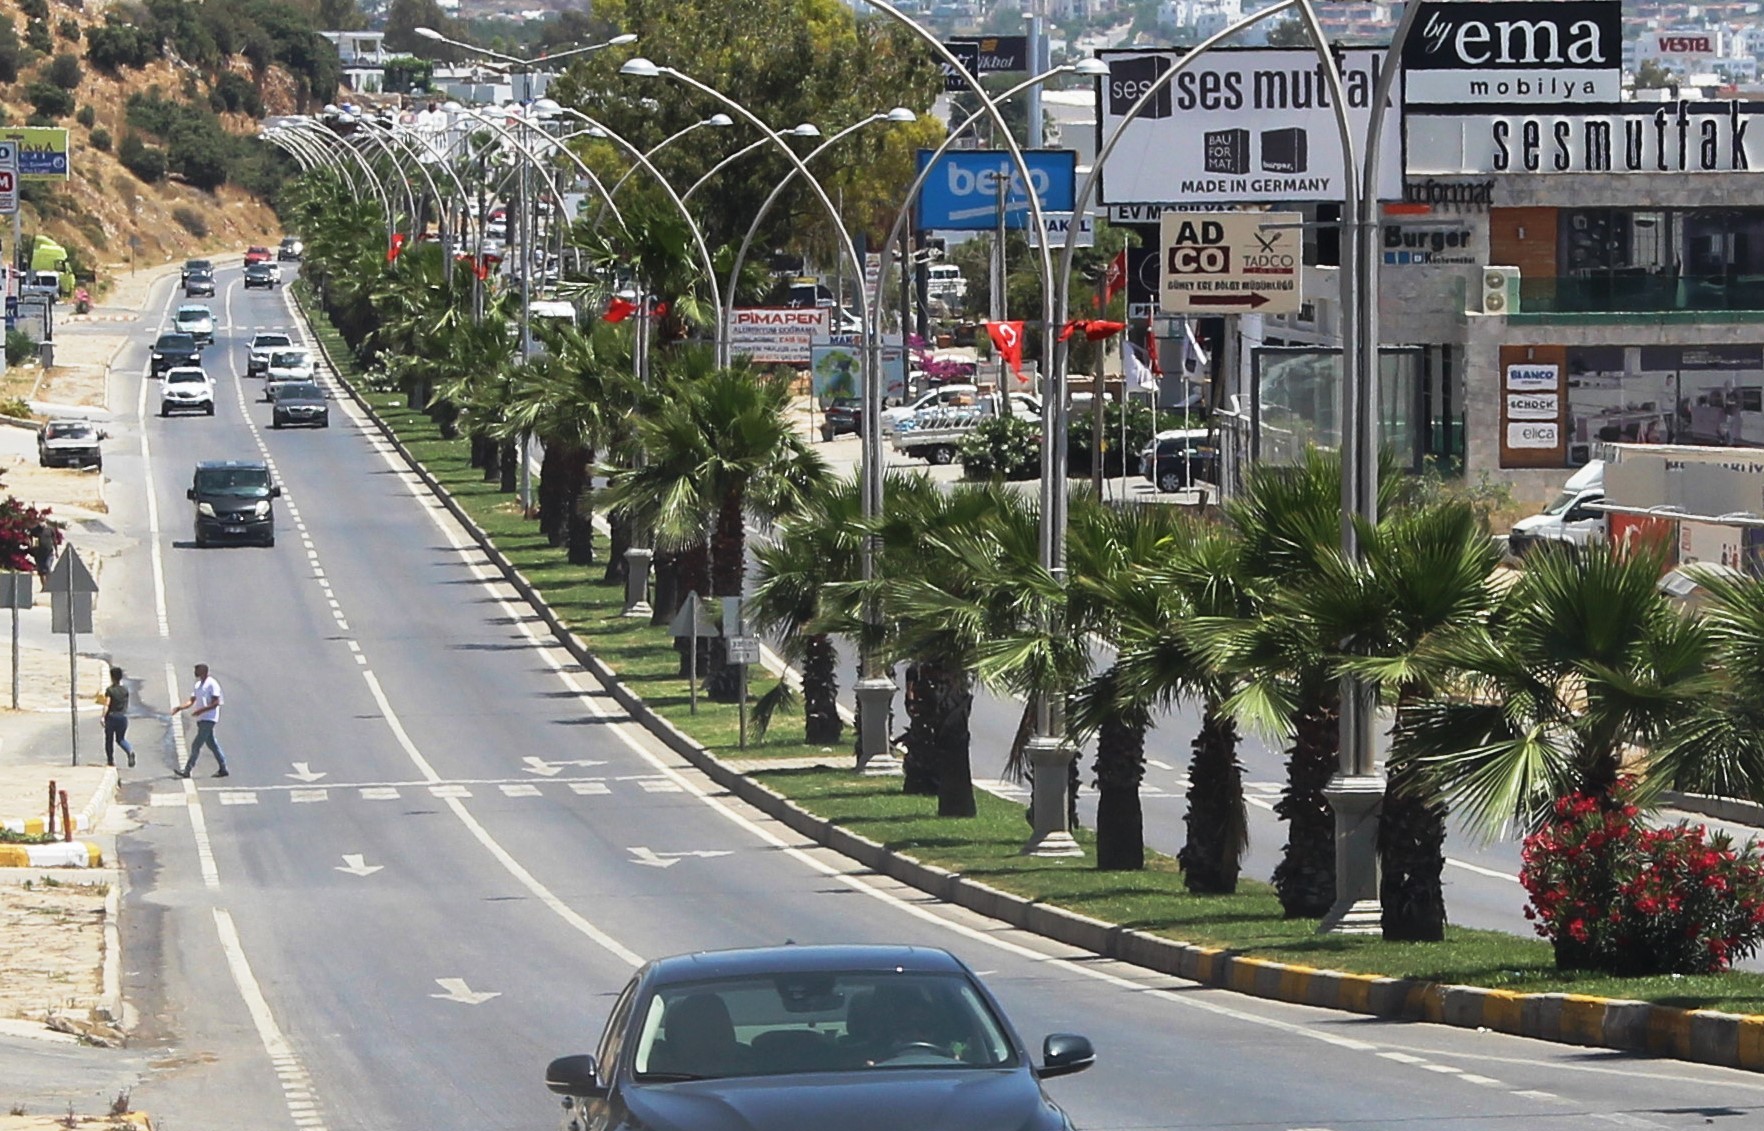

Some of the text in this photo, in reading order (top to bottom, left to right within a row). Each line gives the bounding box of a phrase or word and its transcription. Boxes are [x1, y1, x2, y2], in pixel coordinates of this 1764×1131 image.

[1423, 12, 1606, 64] by ema
[1659, 37, 1714, 52] VESTEL
[1177, 70, 1243, 110] ses
[1470, 79, 1595, 98] mobilya
[1209, 134, 1231, 145] BAU
[1492, 101, 1749, 171] sesmutfak
[1209, 147, 1231, 157] FOR
[948, 161, 1049, 196] beko
[1181, 178, 1330, 194] MADE IN GERMANY
[1176, 221, 1224, 245] AD
[1385, 226, 1470, 252] Burger
[1175, 248, 1224, 272] CO
[1243, 255, 1294, 267] TADCO
[1168, 281, 1195, 290] GÜNEY
[1197, 281, 1212, 290] EGE
[1511, 370, 1554, 380] BLANCO
[1511, 400, 1554, 409] SCHOCK
[1523, 428, 1555, 440] elica
